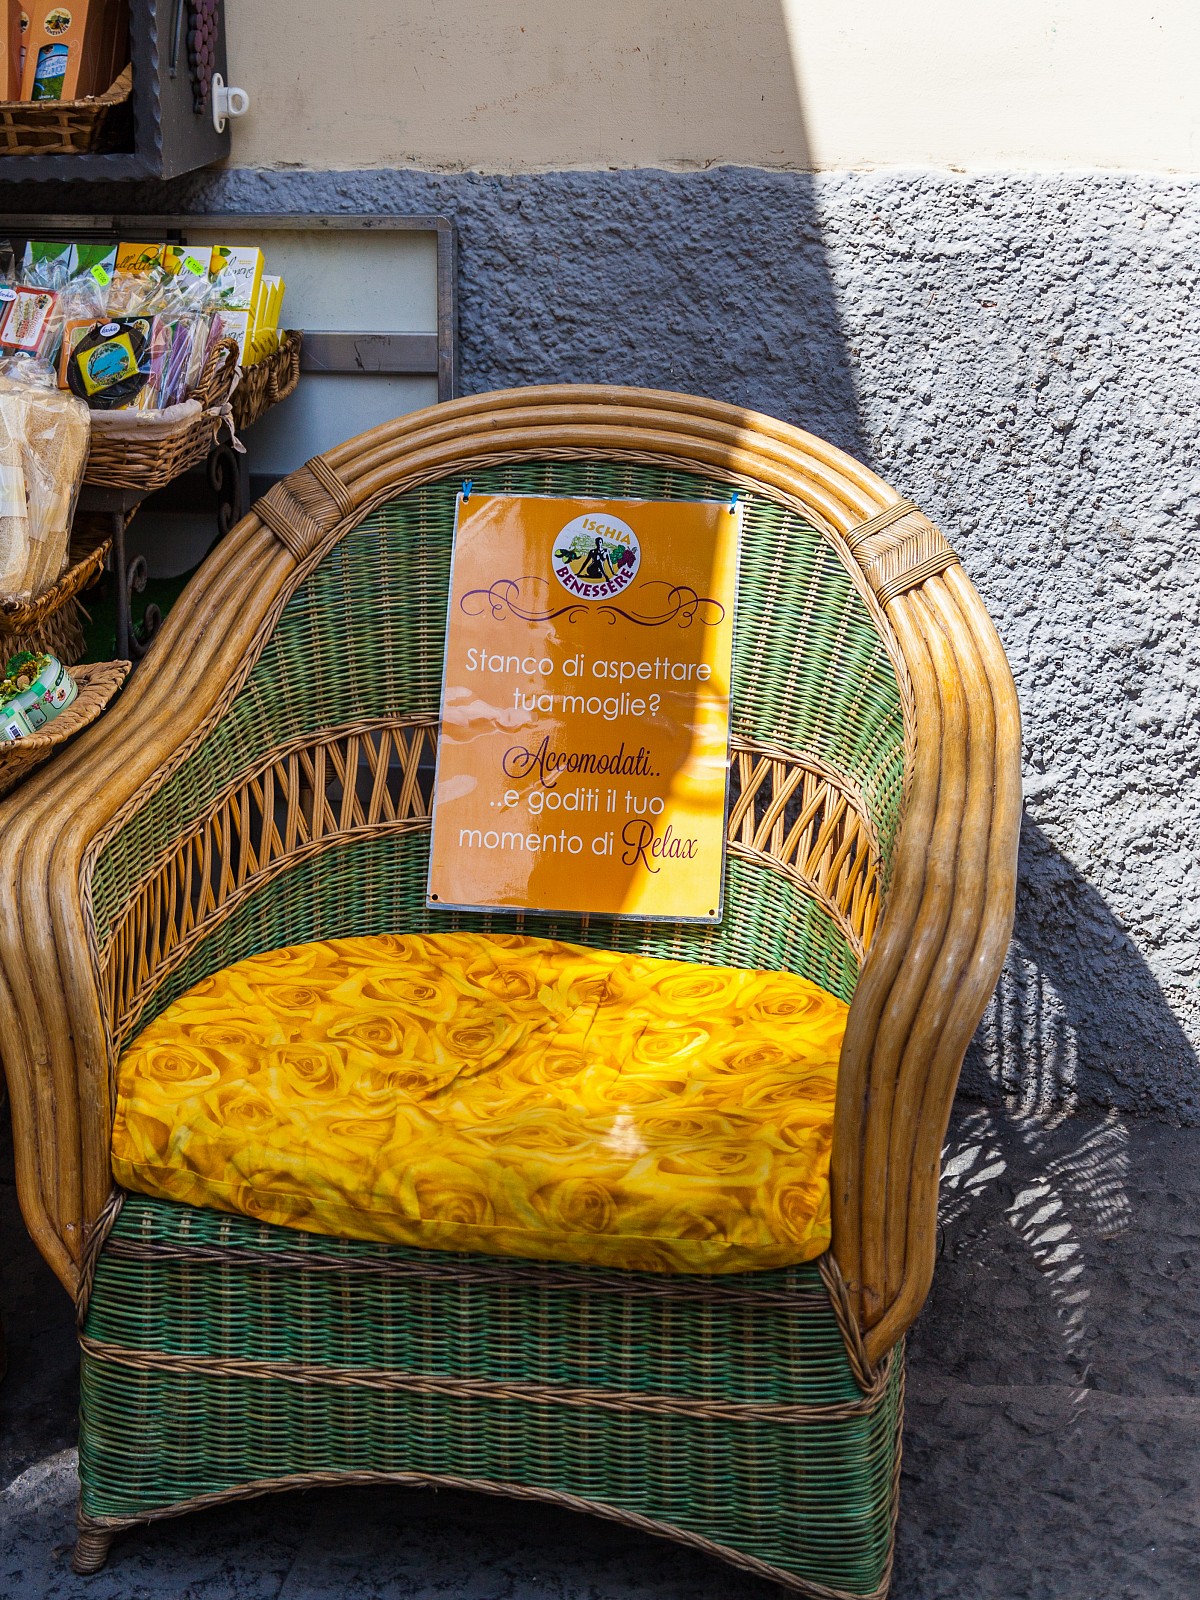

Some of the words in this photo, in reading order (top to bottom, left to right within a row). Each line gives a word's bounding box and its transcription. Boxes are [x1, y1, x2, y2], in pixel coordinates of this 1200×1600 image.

[582, 518, 631, 545] ISCHIA
[556, 566, 635, 597] BENESSERE
[465, 648, 554, 676] Stanco
[562, 654, 584, 677] di
[592, 657, 712, 684] aspettare
[512, 688, 554, 713] tua
[562, 693, 661, 721] moglie?
[502, 736, 661, 789] Accomodati..
[528, 788, 599, 815] goditi
[606, 789, 617, 813] il
[625, 790, 665, 815] tuo
[459, 829, 583, 855] momento
[591, 832, 614, 856] di
[622, 819, 699, 874] Relax
